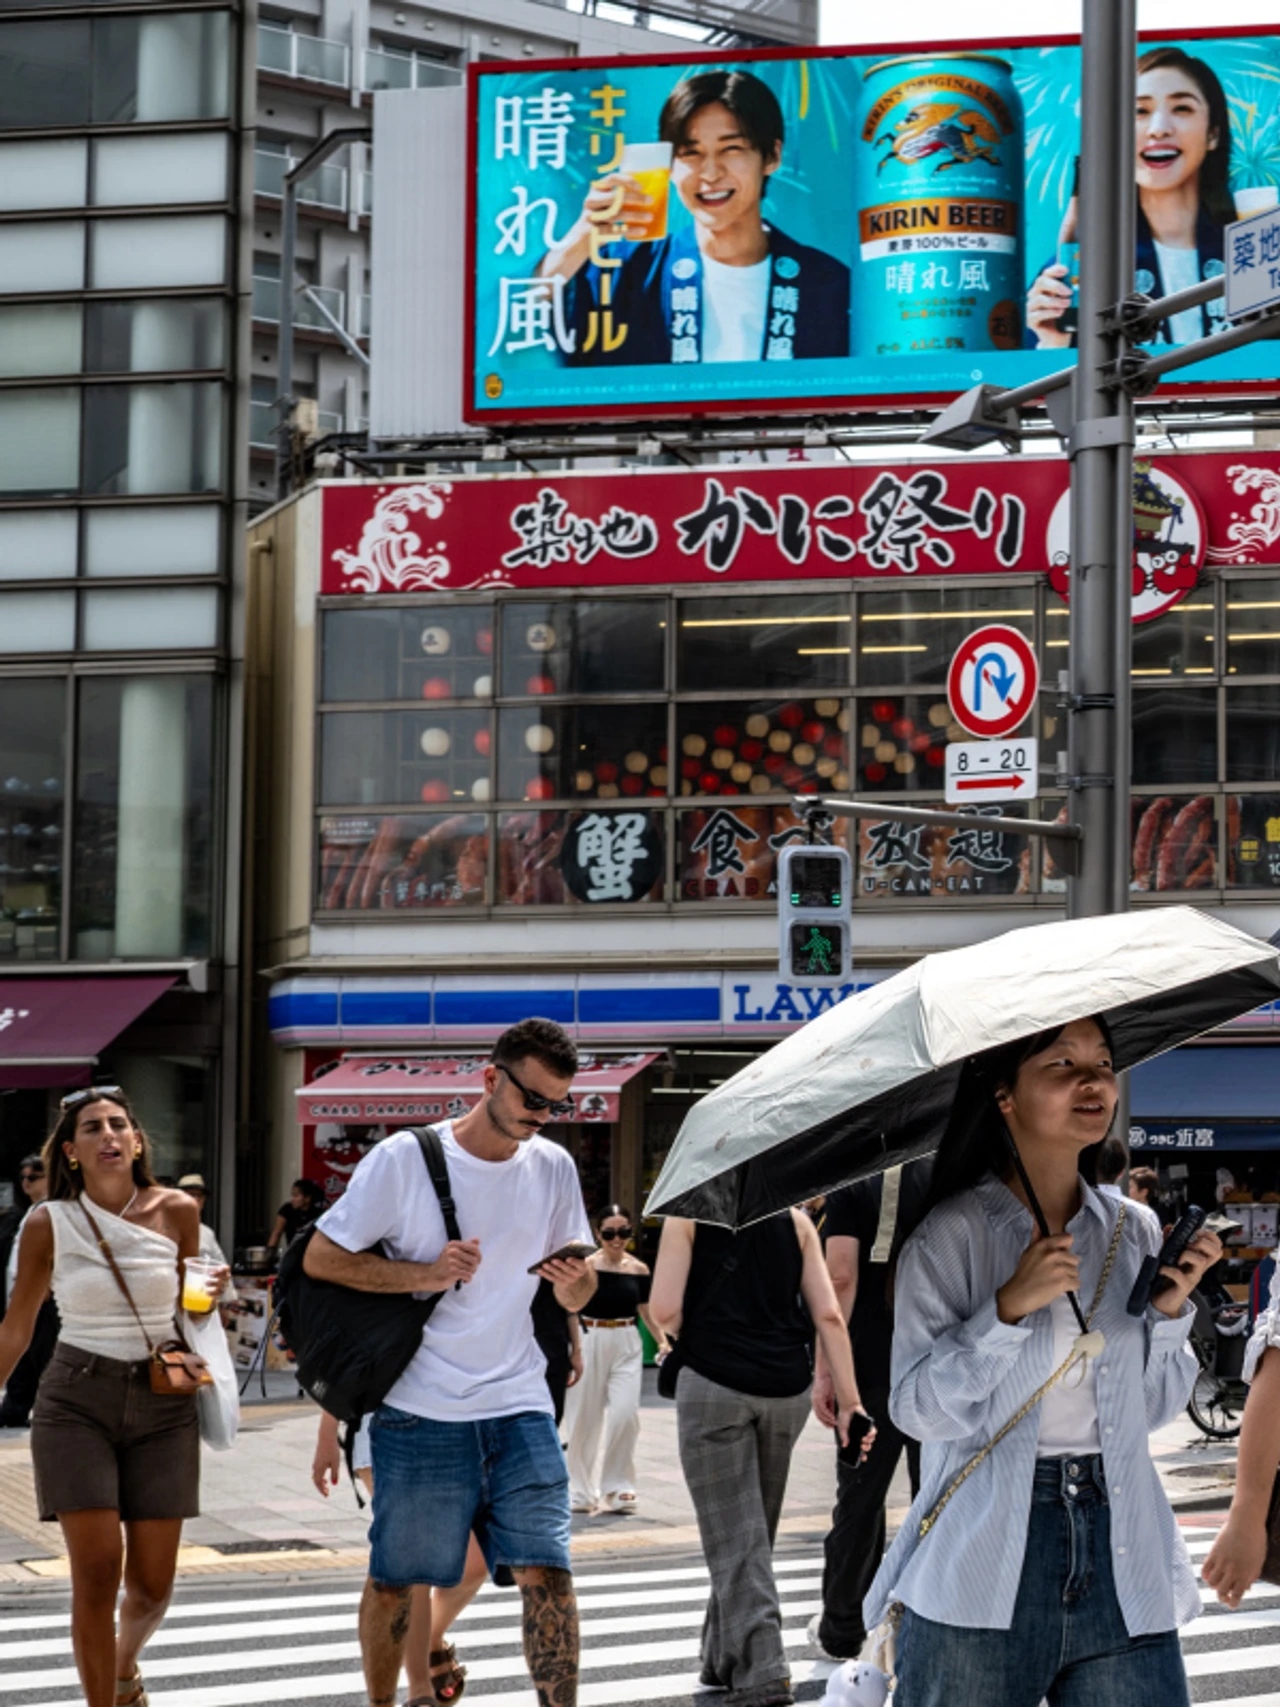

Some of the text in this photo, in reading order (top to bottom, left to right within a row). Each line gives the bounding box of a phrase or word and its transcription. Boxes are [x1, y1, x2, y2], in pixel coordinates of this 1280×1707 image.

[487, 87, 576, 357] 晴れ風
[582, 84, 628, 353] キリンビール
[868, 204, 1007, 236] KIRIN BEER
[885, 259, 991, 295] 晴れ風
[503, 470, 1026, 573] 築地 かに祭り
[575, 812, 649, 901] 蟹
[684, 877, 760, 898] CRAB
[310, 1104, 360, 1117] CRABS
[366, 1103, 443, 1117] PARADISE
